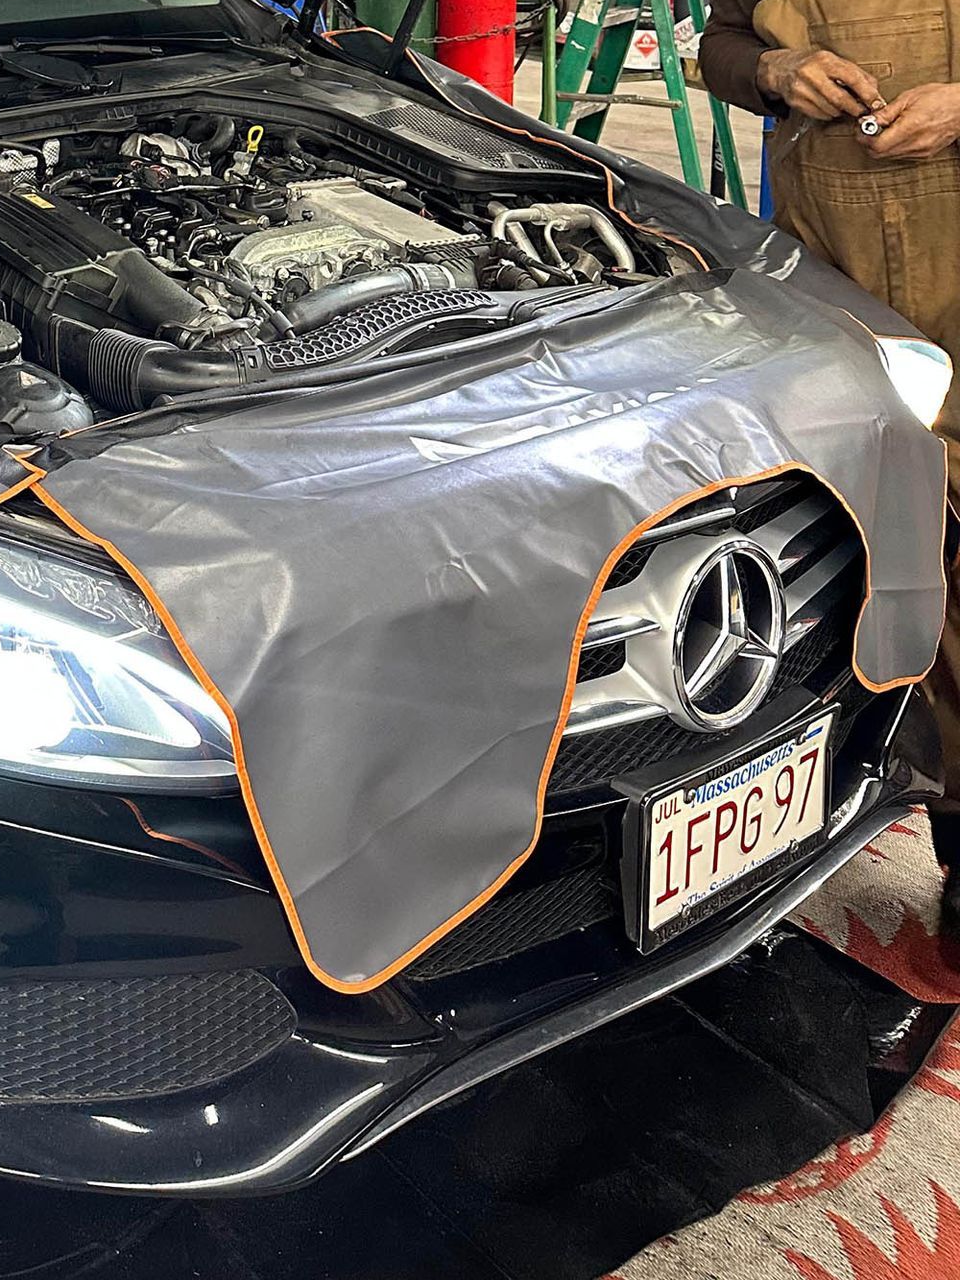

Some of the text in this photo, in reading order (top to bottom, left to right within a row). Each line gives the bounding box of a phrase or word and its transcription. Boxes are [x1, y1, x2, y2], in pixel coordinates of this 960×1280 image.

[692, 741, 795, 805] Massachusetts
[655, 797, 681, 824] JUL
[655, 785, 763, 907] 1FPG
[774, 747, 820, 836] 97
